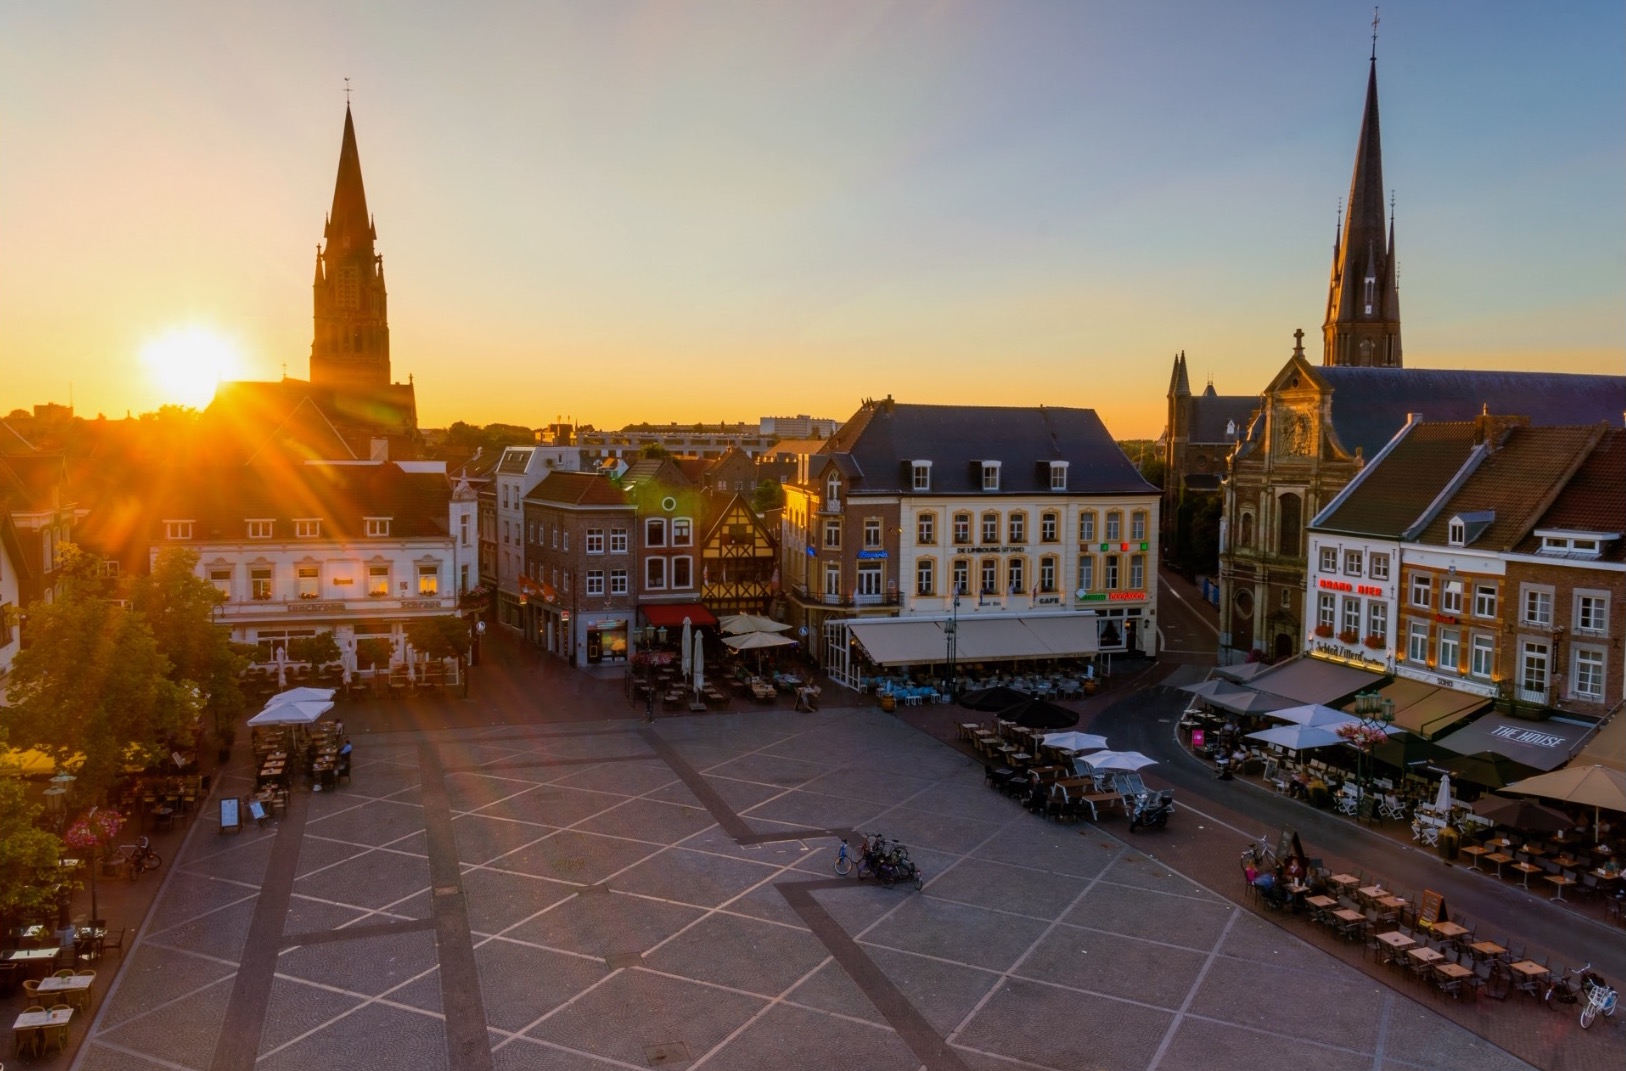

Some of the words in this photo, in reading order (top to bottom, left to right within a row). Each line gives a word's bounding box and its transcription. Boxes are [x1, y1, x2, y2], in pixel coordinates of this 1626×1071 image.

[1319, 579, 1352, 592] BRAND
[1357, 585, 1383, 596] BIER
[1437, 678, 1453, 687] SOHO
[1491, 725, 1520, 737] THE
[1516, 731, 1566, 747] HOUSE
